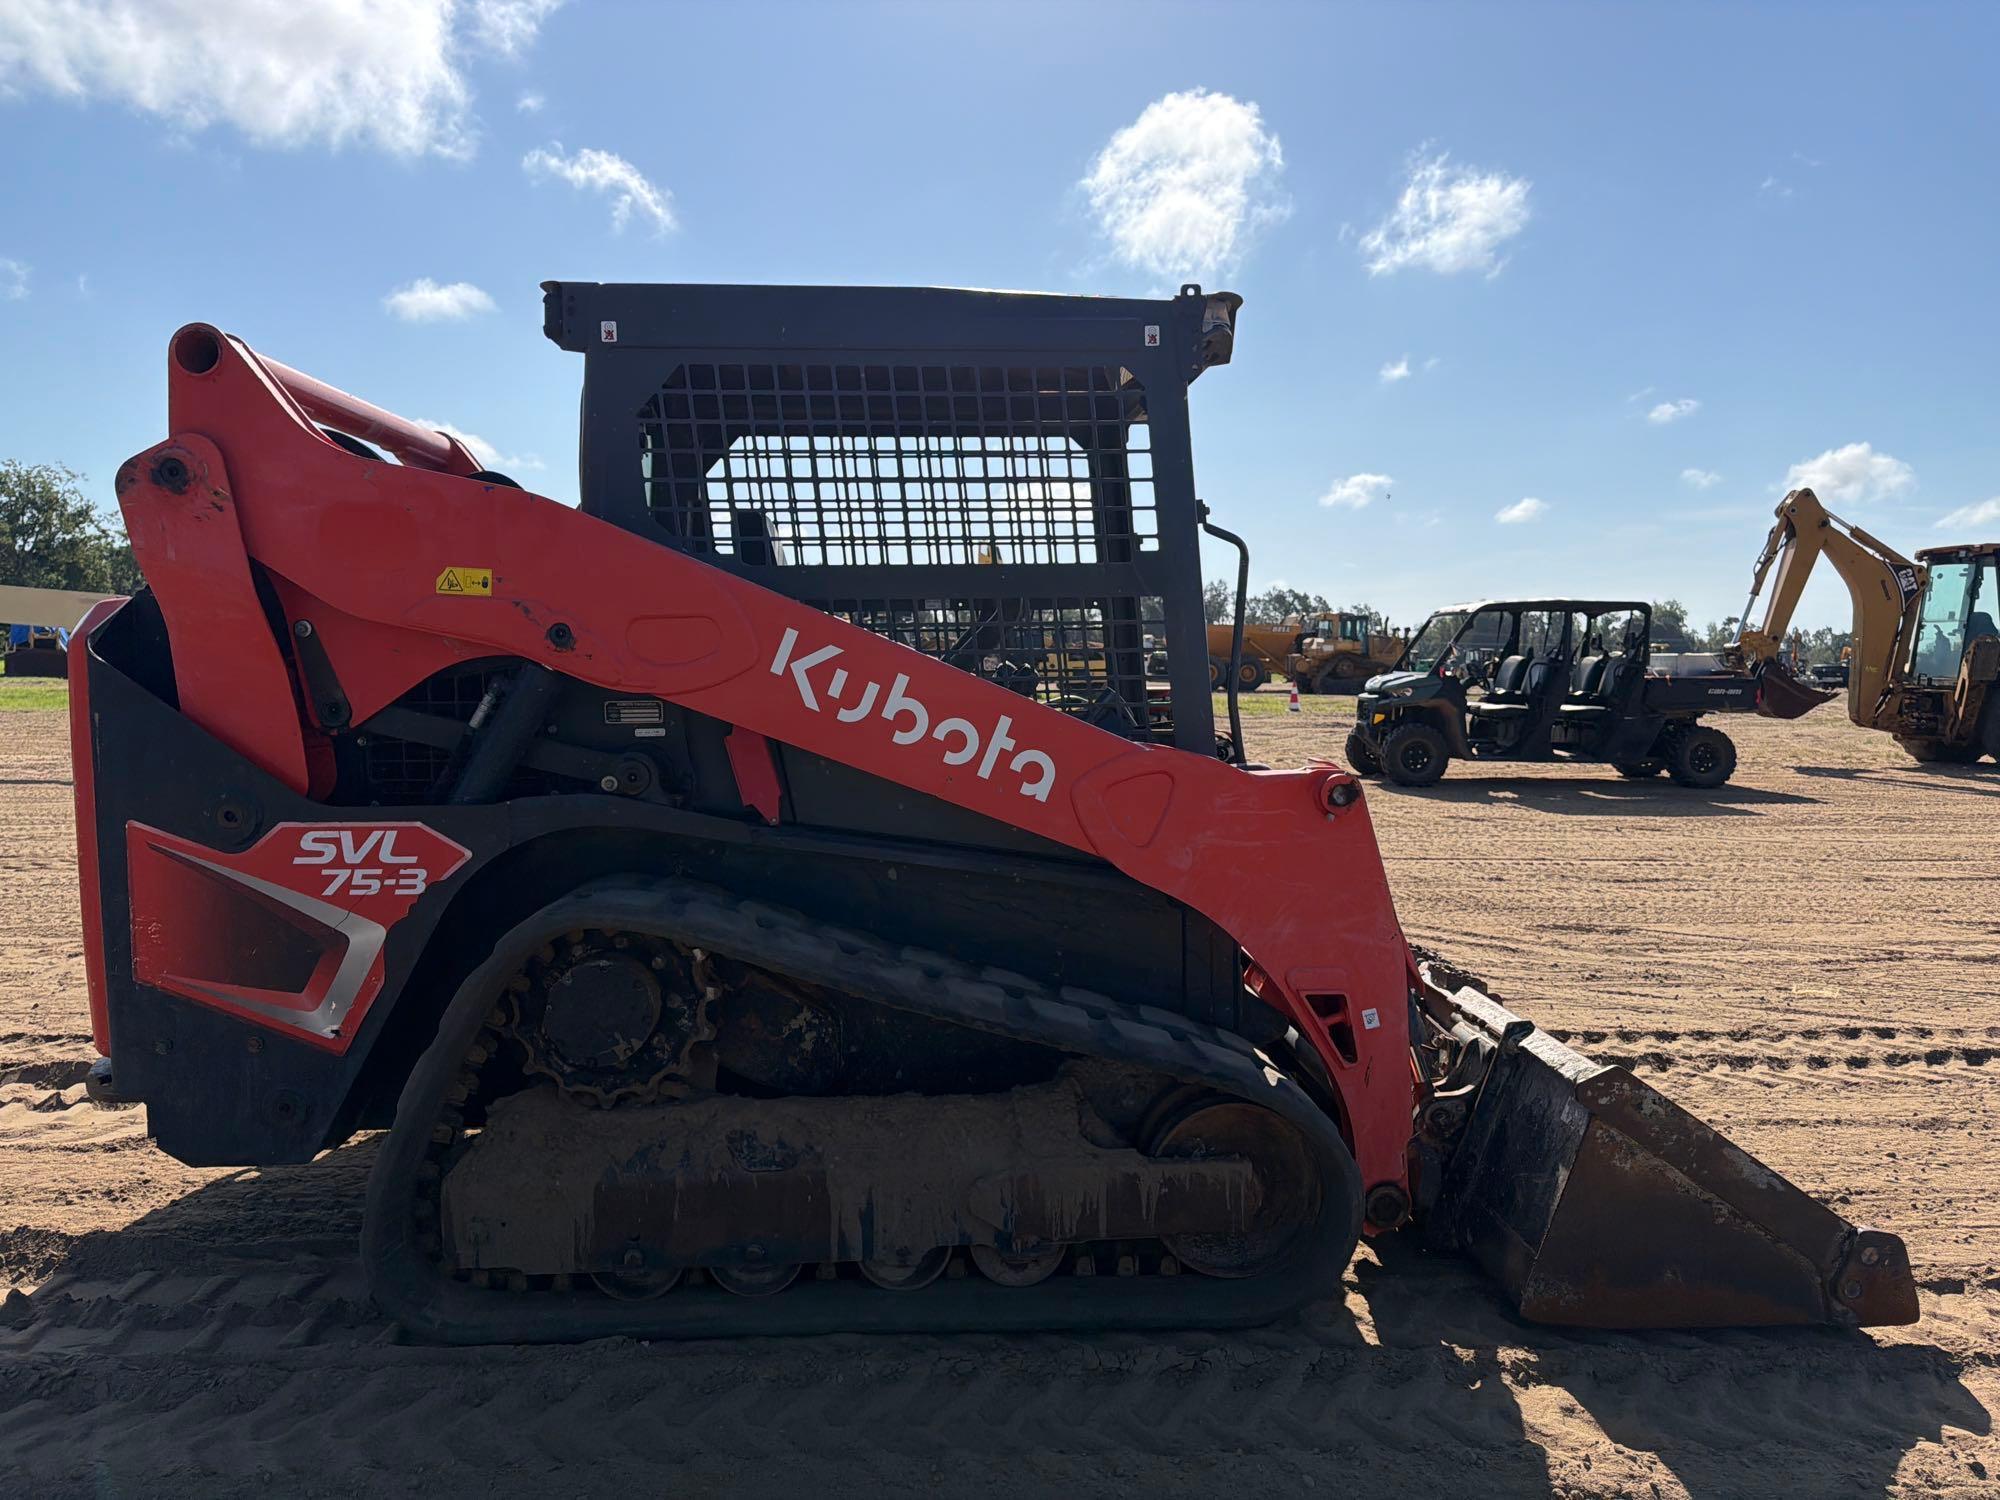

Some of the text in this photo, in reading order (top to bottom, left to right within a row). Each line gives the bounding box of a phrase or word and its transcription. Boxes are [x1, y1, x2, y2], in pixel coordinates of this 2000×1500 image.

[1898, 568, 1918, 592] CAT
[769, 626, 1056, 803] Kubota
[292, 830, 418, 865] SVL
[320, 868, 428, 896] 75-3
